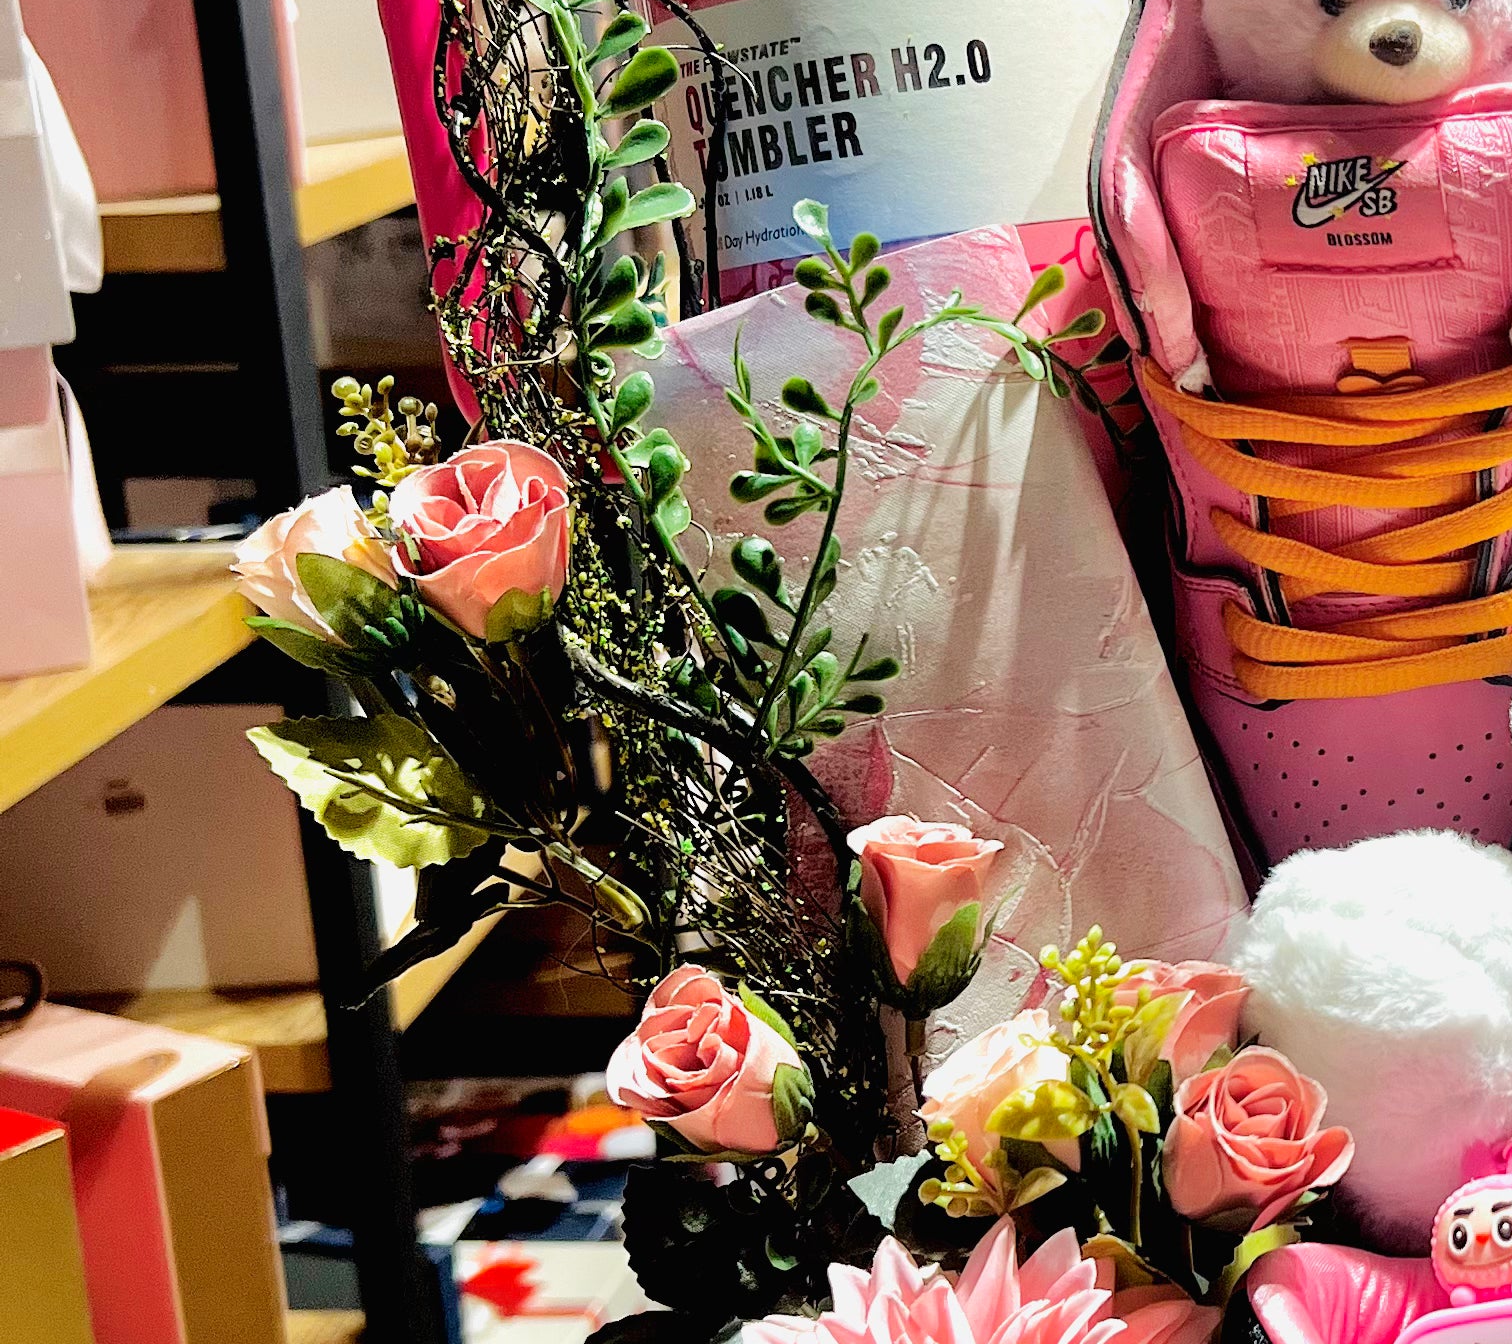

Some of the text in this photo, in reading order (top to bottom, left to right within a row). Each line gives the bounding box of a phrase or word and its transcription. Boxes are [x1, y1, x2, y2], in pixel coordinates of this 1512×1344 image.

[680, 59, 700, 78] THE
[890, 38, 992, 93] H2.0
[1307, 156, 1370, 198] NIKE
[766, 185, 773, 197] L
[1361, 188, 1395, 216] SB
[725, 235, 743, 251] Day
